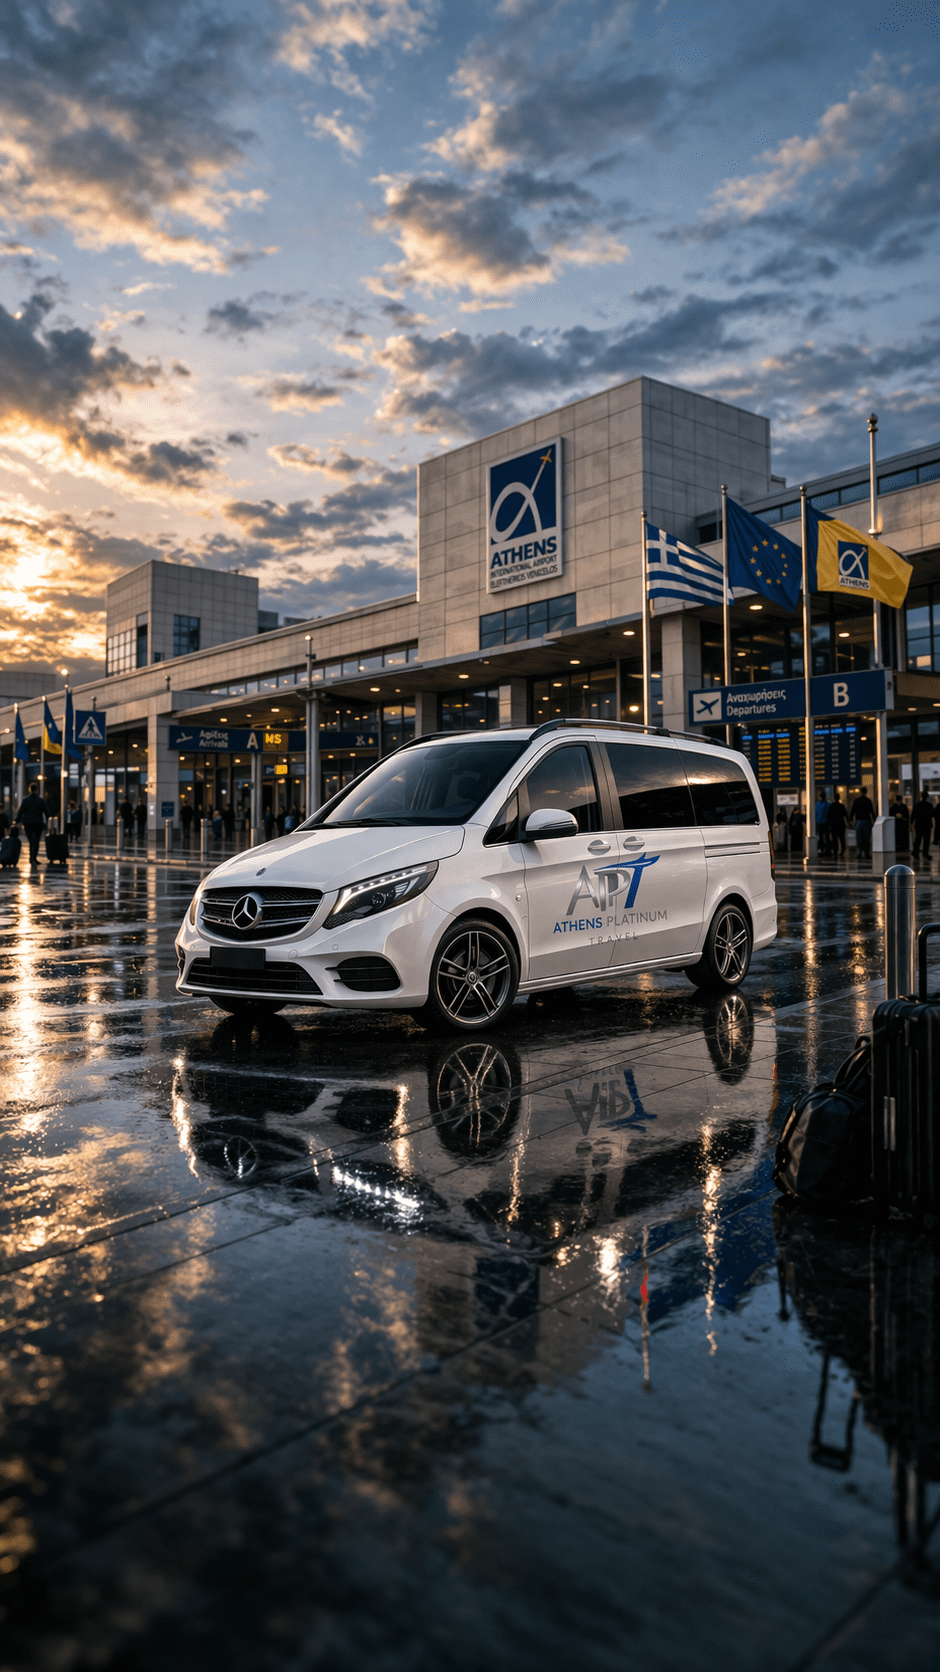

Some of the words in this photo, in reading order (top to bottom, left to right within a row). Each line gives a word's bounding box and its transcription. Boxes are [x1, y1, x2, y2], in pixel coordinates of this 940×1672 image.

[490, 536, 557, 569] ATHENS
[840, 577, 869, 588] ATHENS
[833, 682, 850, 707] B
[726, 703, 777, 718] Departures
[246, 732, 259, 749] A
[553, 917, 603, 934] ATHENS
[606, 910, 668, 927] PLATINUM
[589, 931, 638, 946] TRAVEL
